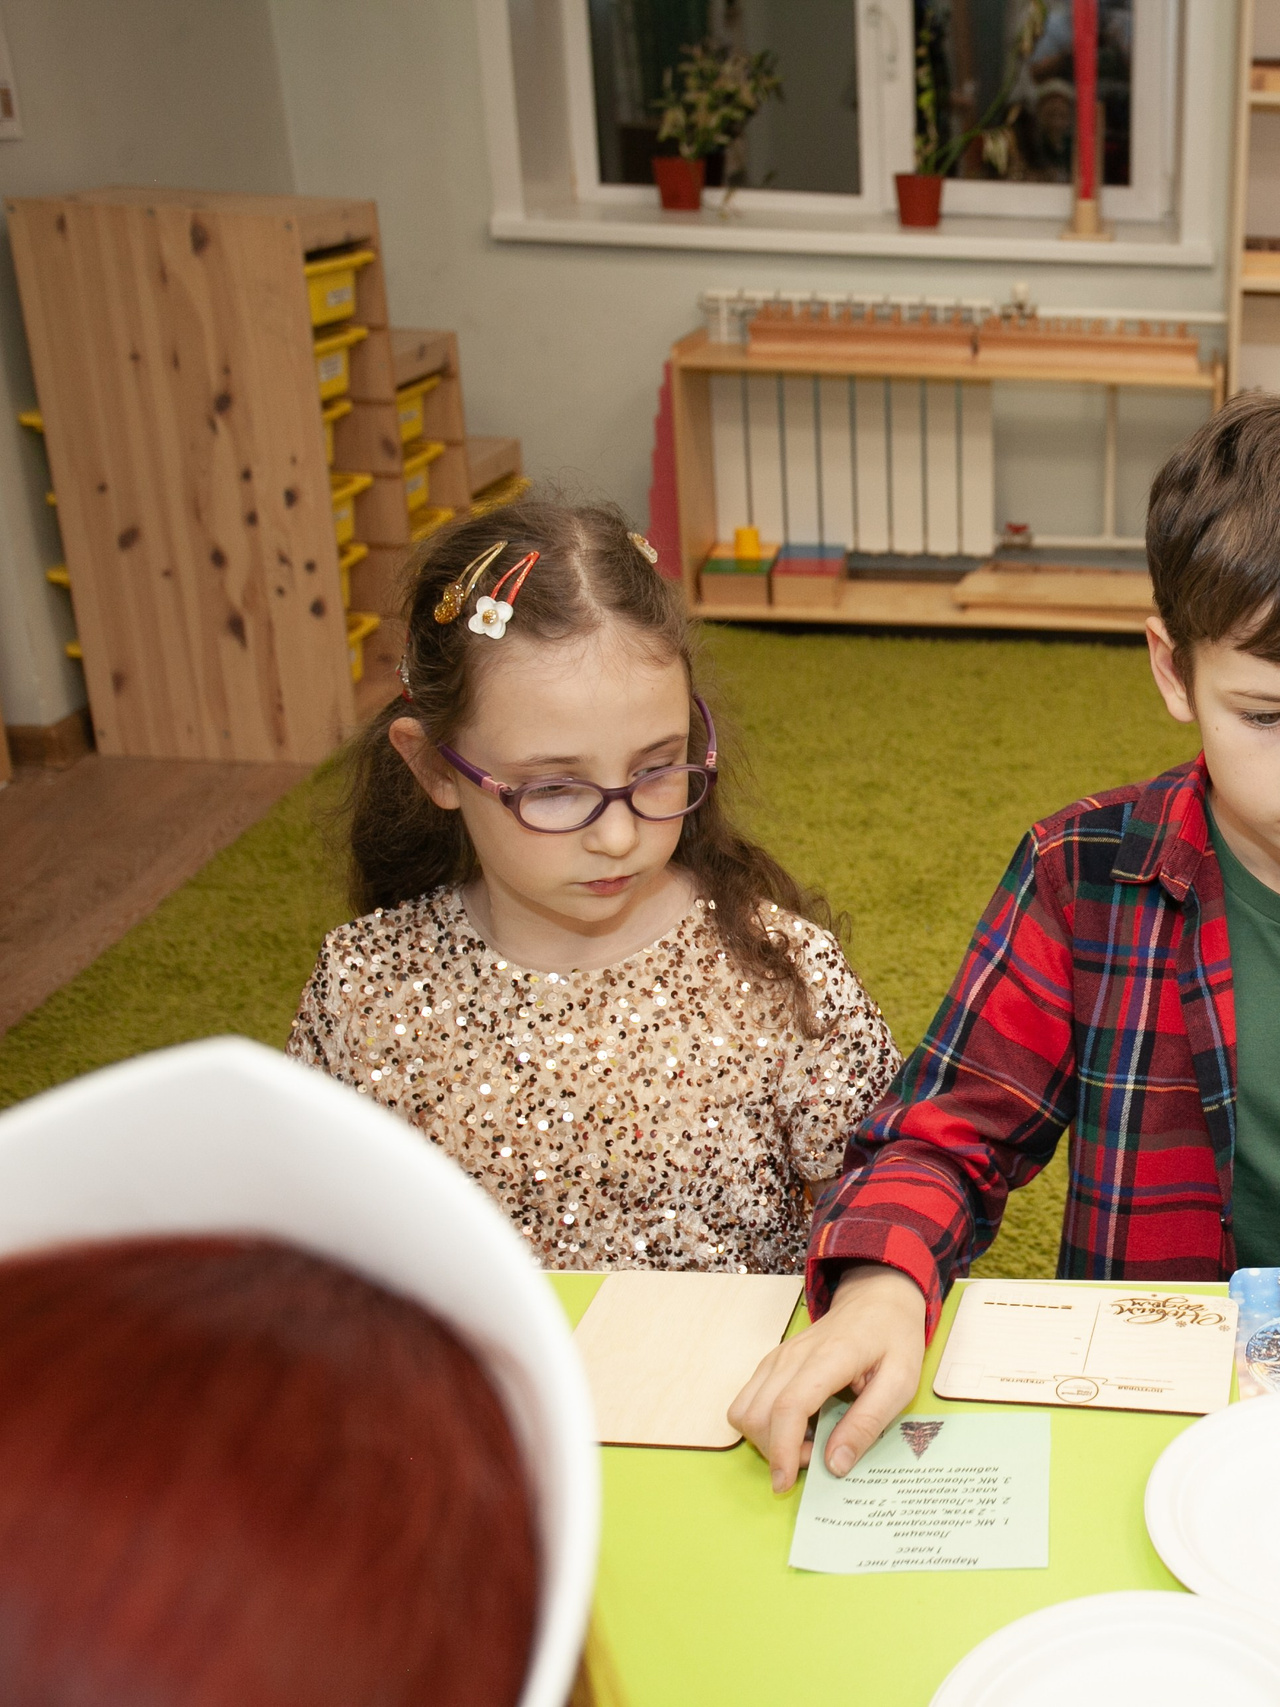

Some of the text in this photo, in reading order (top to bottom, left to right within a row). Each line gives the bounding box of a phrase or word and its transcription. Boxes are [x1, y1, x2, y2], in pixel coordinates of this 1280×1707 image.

[947, 1466, 999, 1474] кабинет
[892, 1477, 975, 1485] «Новогодняя
[977, 1477, 998, 1485] МК
[897, 1486, 959, 1494] керамики
[878, 1499, 887, 1507] 2
[901, 1498, 974, 1506] «Лошадка»
[976, 1497, 997, 1505] МК
[978, 1508, 986, 1516] 2
[815, 1517, 883, 1527] открытка»
[974, 1519, 996, 1527] МК
[893, 1530, 951, 1539] Локация
[896, 1546, 934, 1554] класс
[891, 1557, 979, 1567] Маршрутный
